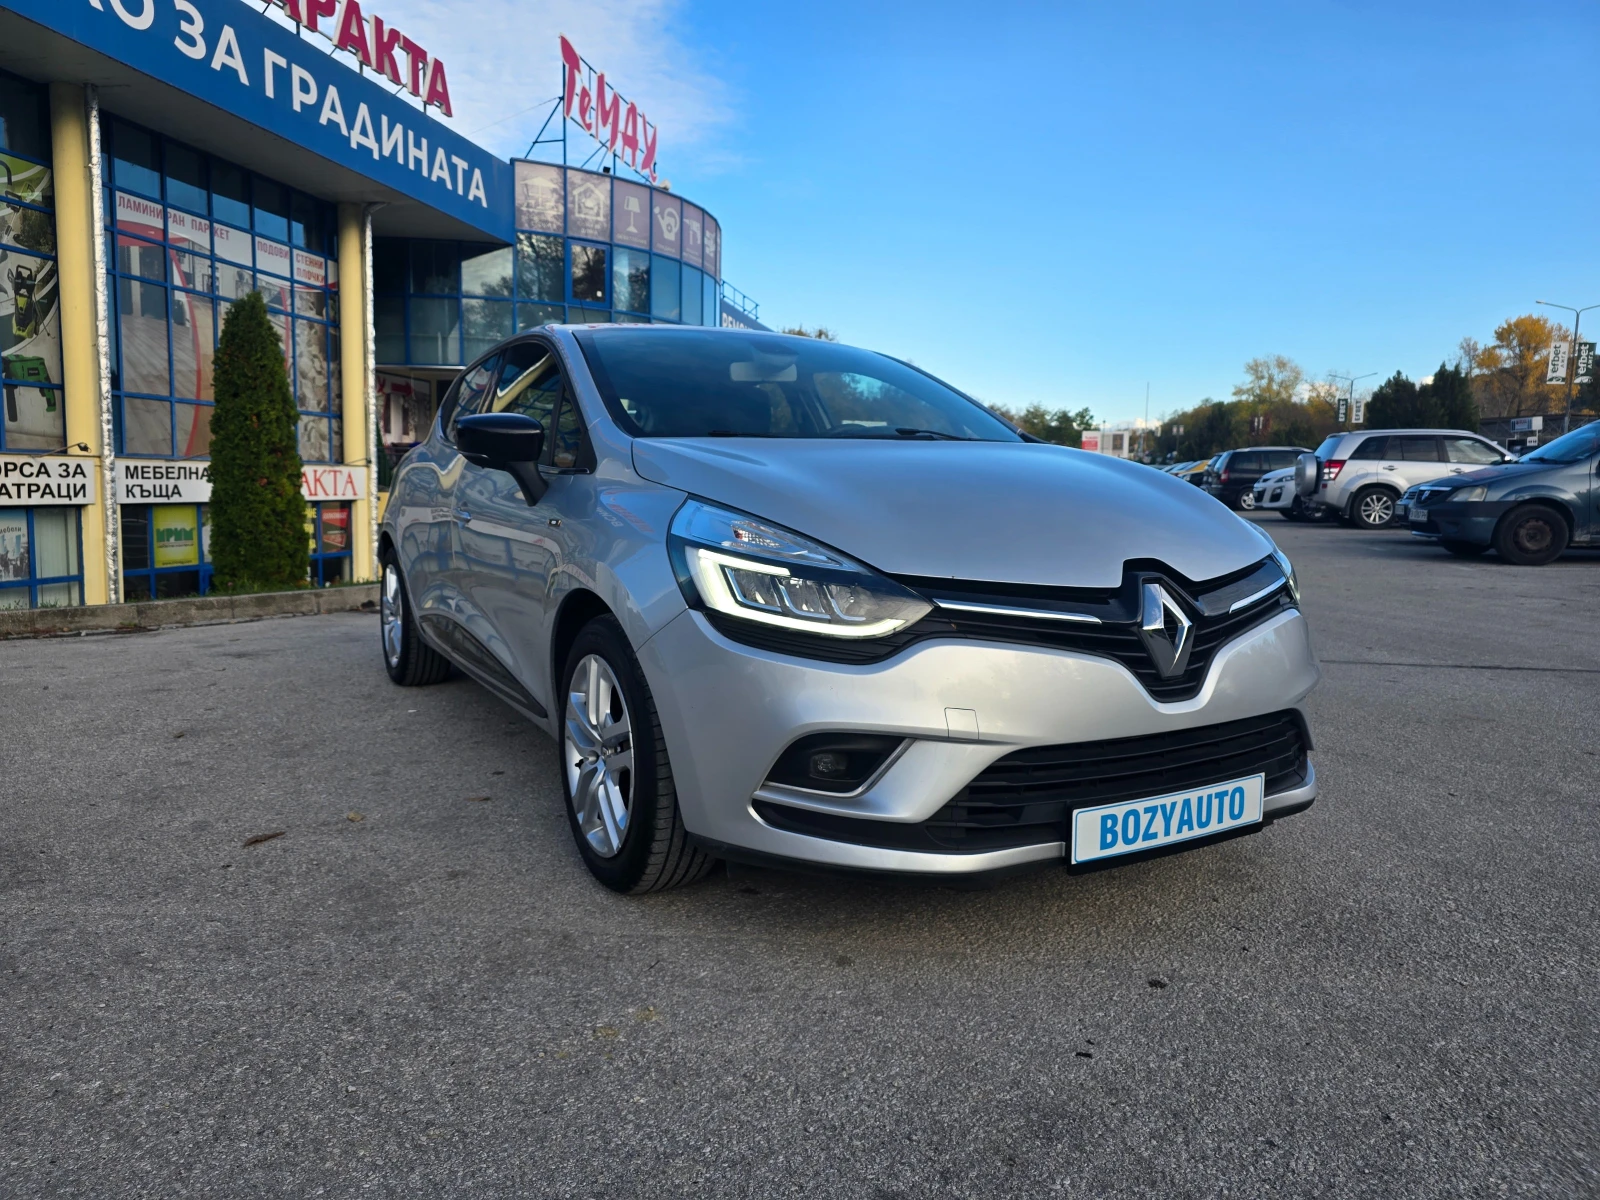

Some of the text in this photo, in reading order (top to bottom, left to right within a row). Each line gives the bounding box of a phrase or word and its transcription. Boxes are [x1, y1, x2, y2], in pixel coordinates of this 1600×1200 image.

[173, 0, 488, 208] ЗА ГРАДИНАТА
[118, 195, 230, 241] ЛАМИНИРАН ПАРКЕТ
[257, 240, 289, 260] ПОДОВИ
[1551, 344, 1562, 374] efbet
[1578, 344, 1590, 375] efbet
[0, 462, 87, 479] РСА ЗА
[125, 465, 211, 480] МЕБЕЛНА
[125, 484, 182, 500] КЪЩА
[1100, 786, 1245, 851] BOZYAUTO
